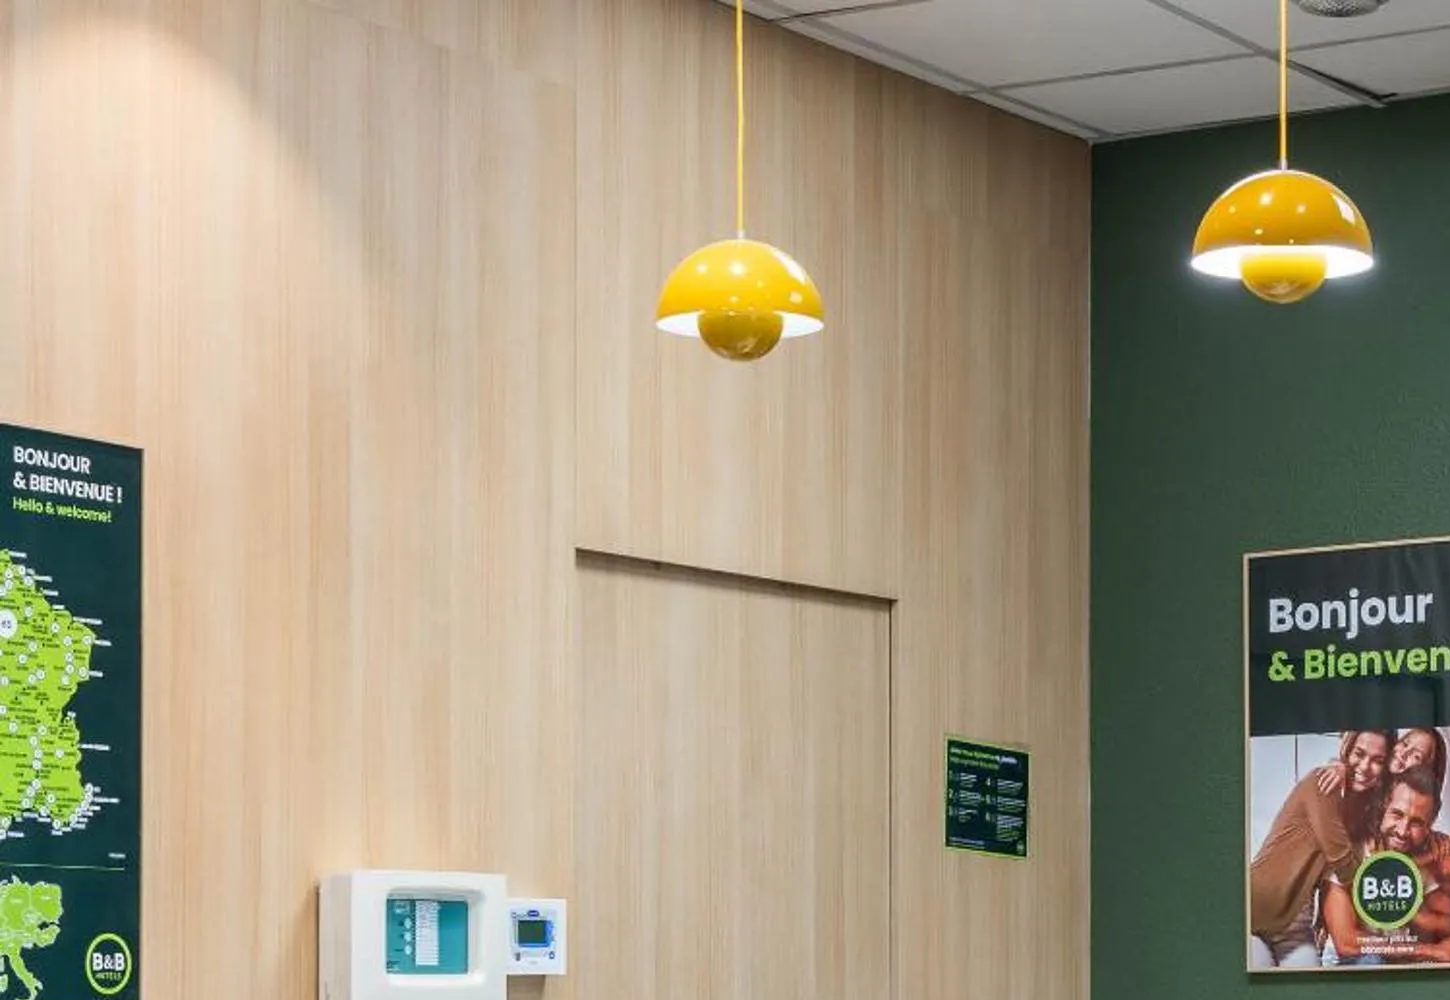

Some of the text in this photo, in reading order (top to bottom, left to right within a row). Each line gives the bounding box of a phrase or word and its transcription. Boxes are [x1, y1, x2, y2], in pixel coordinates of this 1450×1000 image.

[13, 446, 91, 475] BONJOUR
[13, 471, 123, 504] & BIENVENUE !
[13, 496, 112, 523] Hello & welcome!
[1269, 588, 1434, 640] Bonjour
[1268, 650, 1296, 682] &
[1363, 875, 1413, 900] B&B
[92, 952, 125, 971] B&B
